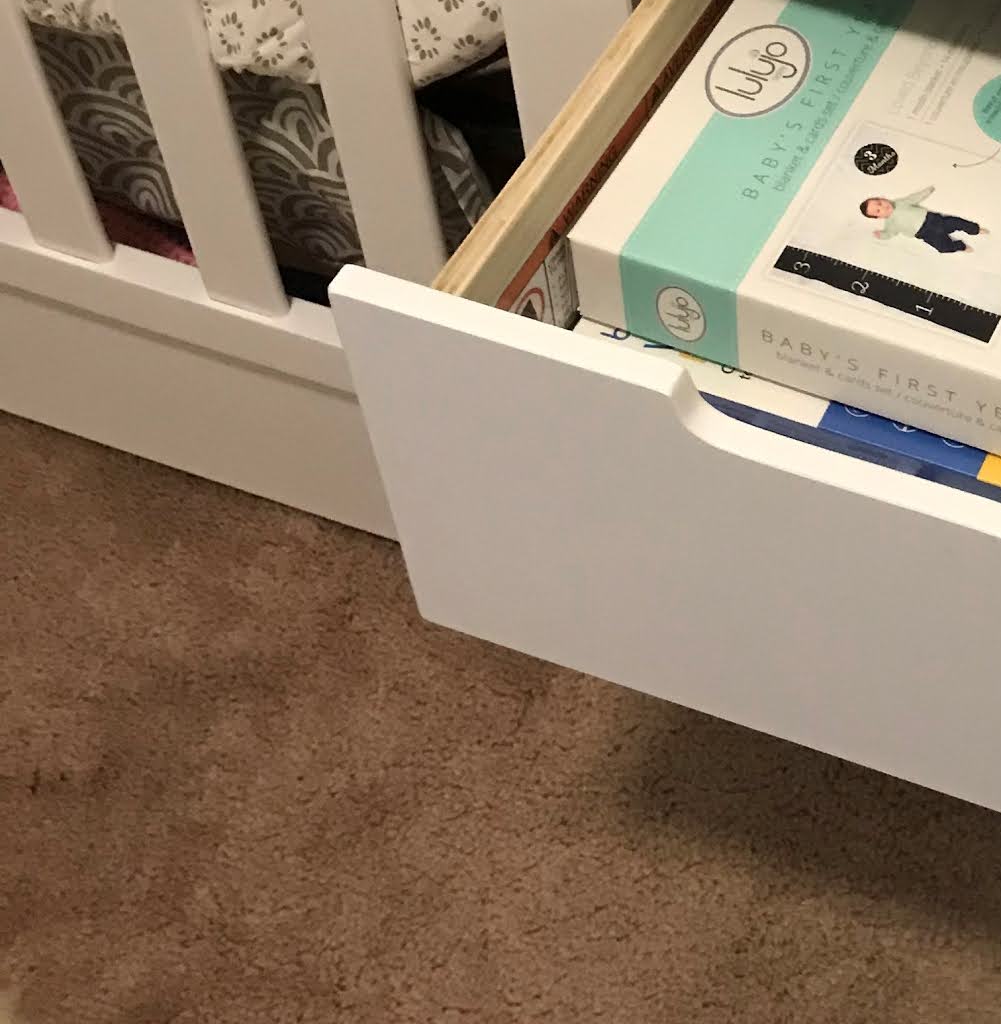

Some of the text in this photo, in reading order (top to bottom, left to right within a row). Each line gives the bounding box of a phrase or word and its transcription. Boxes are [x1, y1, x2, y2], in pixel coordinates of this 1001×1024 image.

[714, 40, 798, 101] lulujo
[741, 120, 803, 201] BABY'S
[800, 47, 847, 108] FIRST
[863, 150, 878, 161] 3
[866, 151, 897, 174] Months
[793, 261, 811, 274] 3
[851, 280, 871, 295] 2
[915, 303, 935, 317] 1
[760, 328, 859, 372] BABY'S
[878, 366, 957, 403] FIRST
